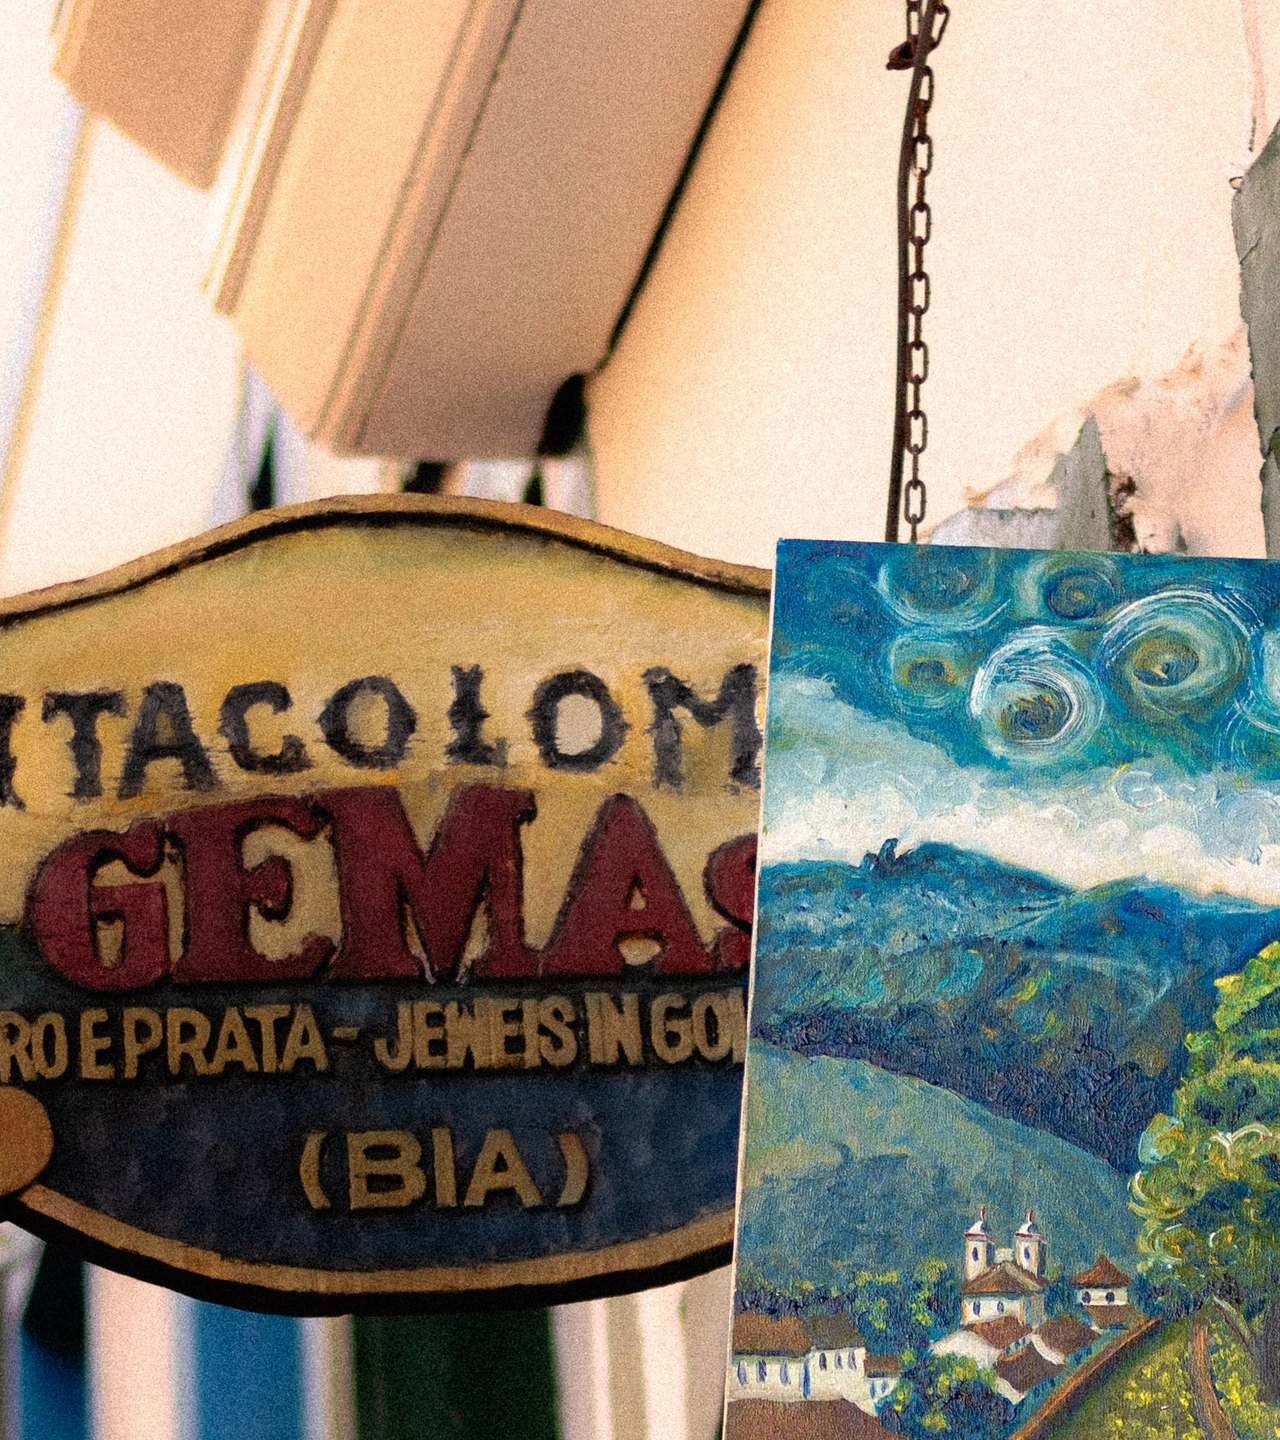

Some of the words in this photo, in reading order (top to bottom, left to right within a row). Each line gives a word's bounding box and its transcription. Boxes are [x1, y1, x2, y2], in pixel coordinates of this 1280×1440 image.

[80, 1007, 116, 1079] E
[584, 992, 643, 1065] IN
[298, 1127, 589, 1211] (BIA)
